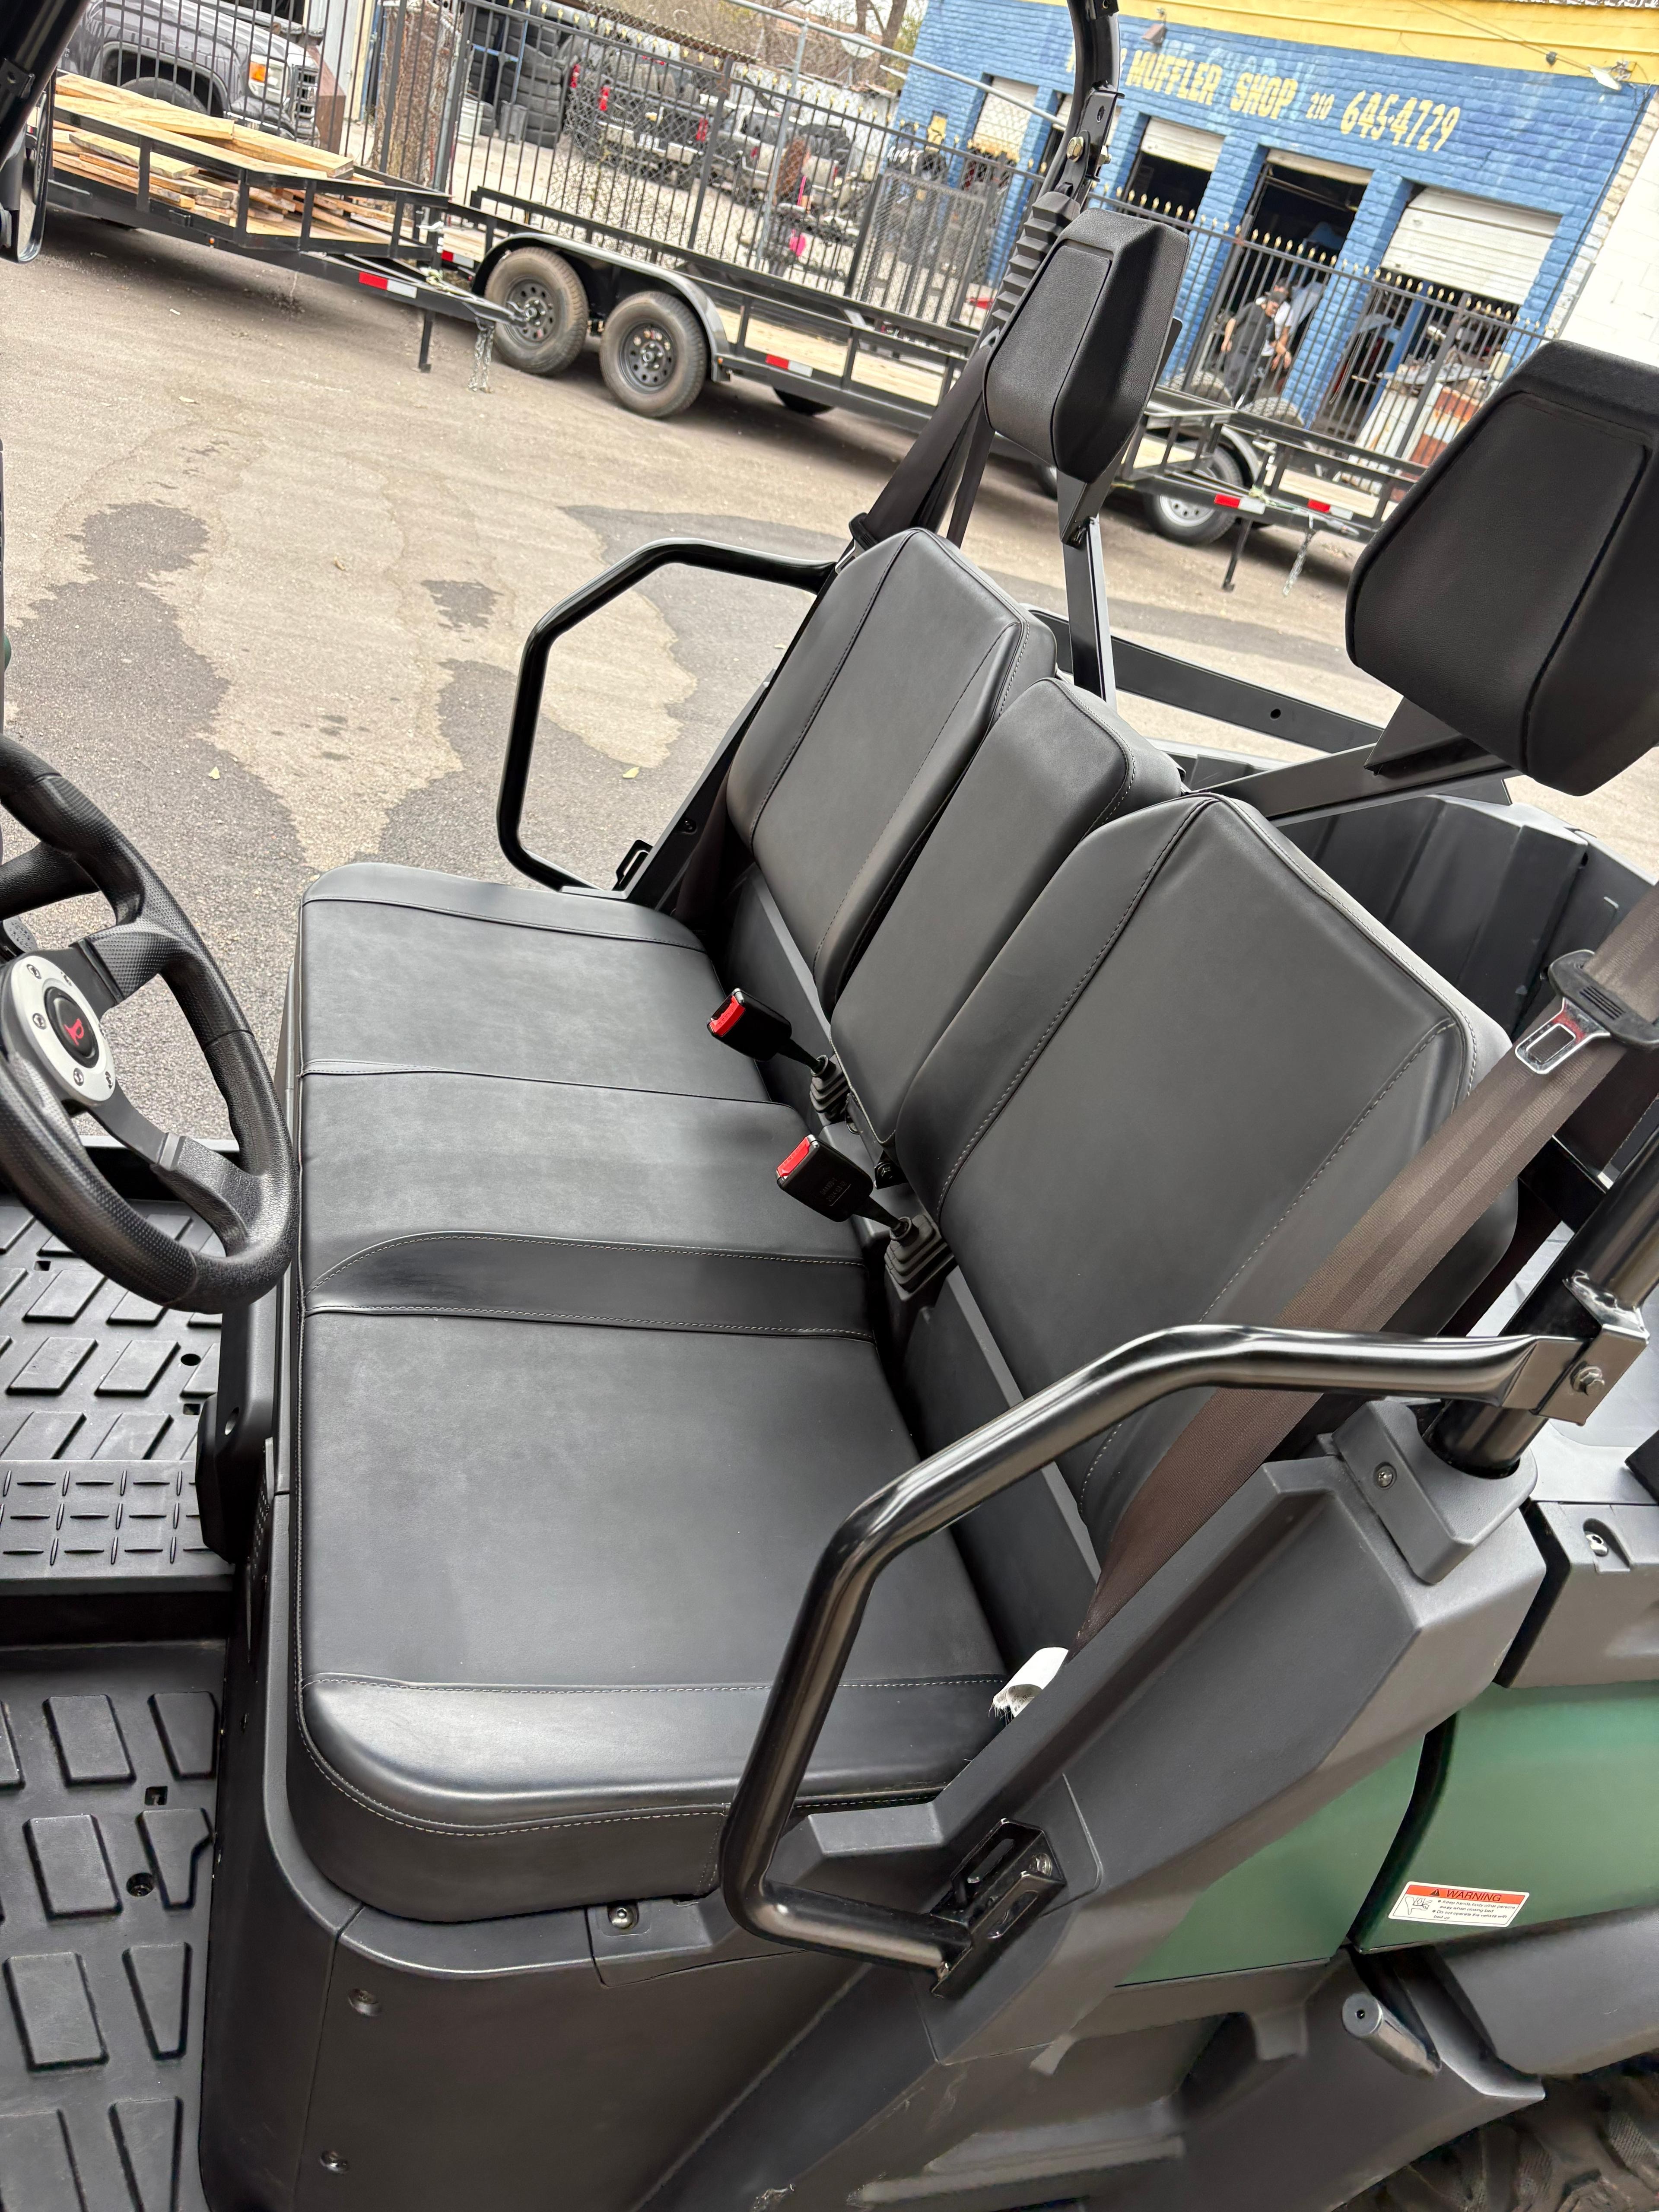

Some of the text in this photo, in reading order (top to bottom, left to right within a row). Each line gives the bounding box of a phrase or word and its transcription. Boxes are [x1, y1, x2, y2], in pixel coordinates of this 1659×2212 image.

[1125, 49, 1223, 105] MUFFLER
[1230, 72, 1298, 120] SHOP
[1305, 92, 1335, 120] 210
[1447, 1889, 1502, 1901] WARNING
